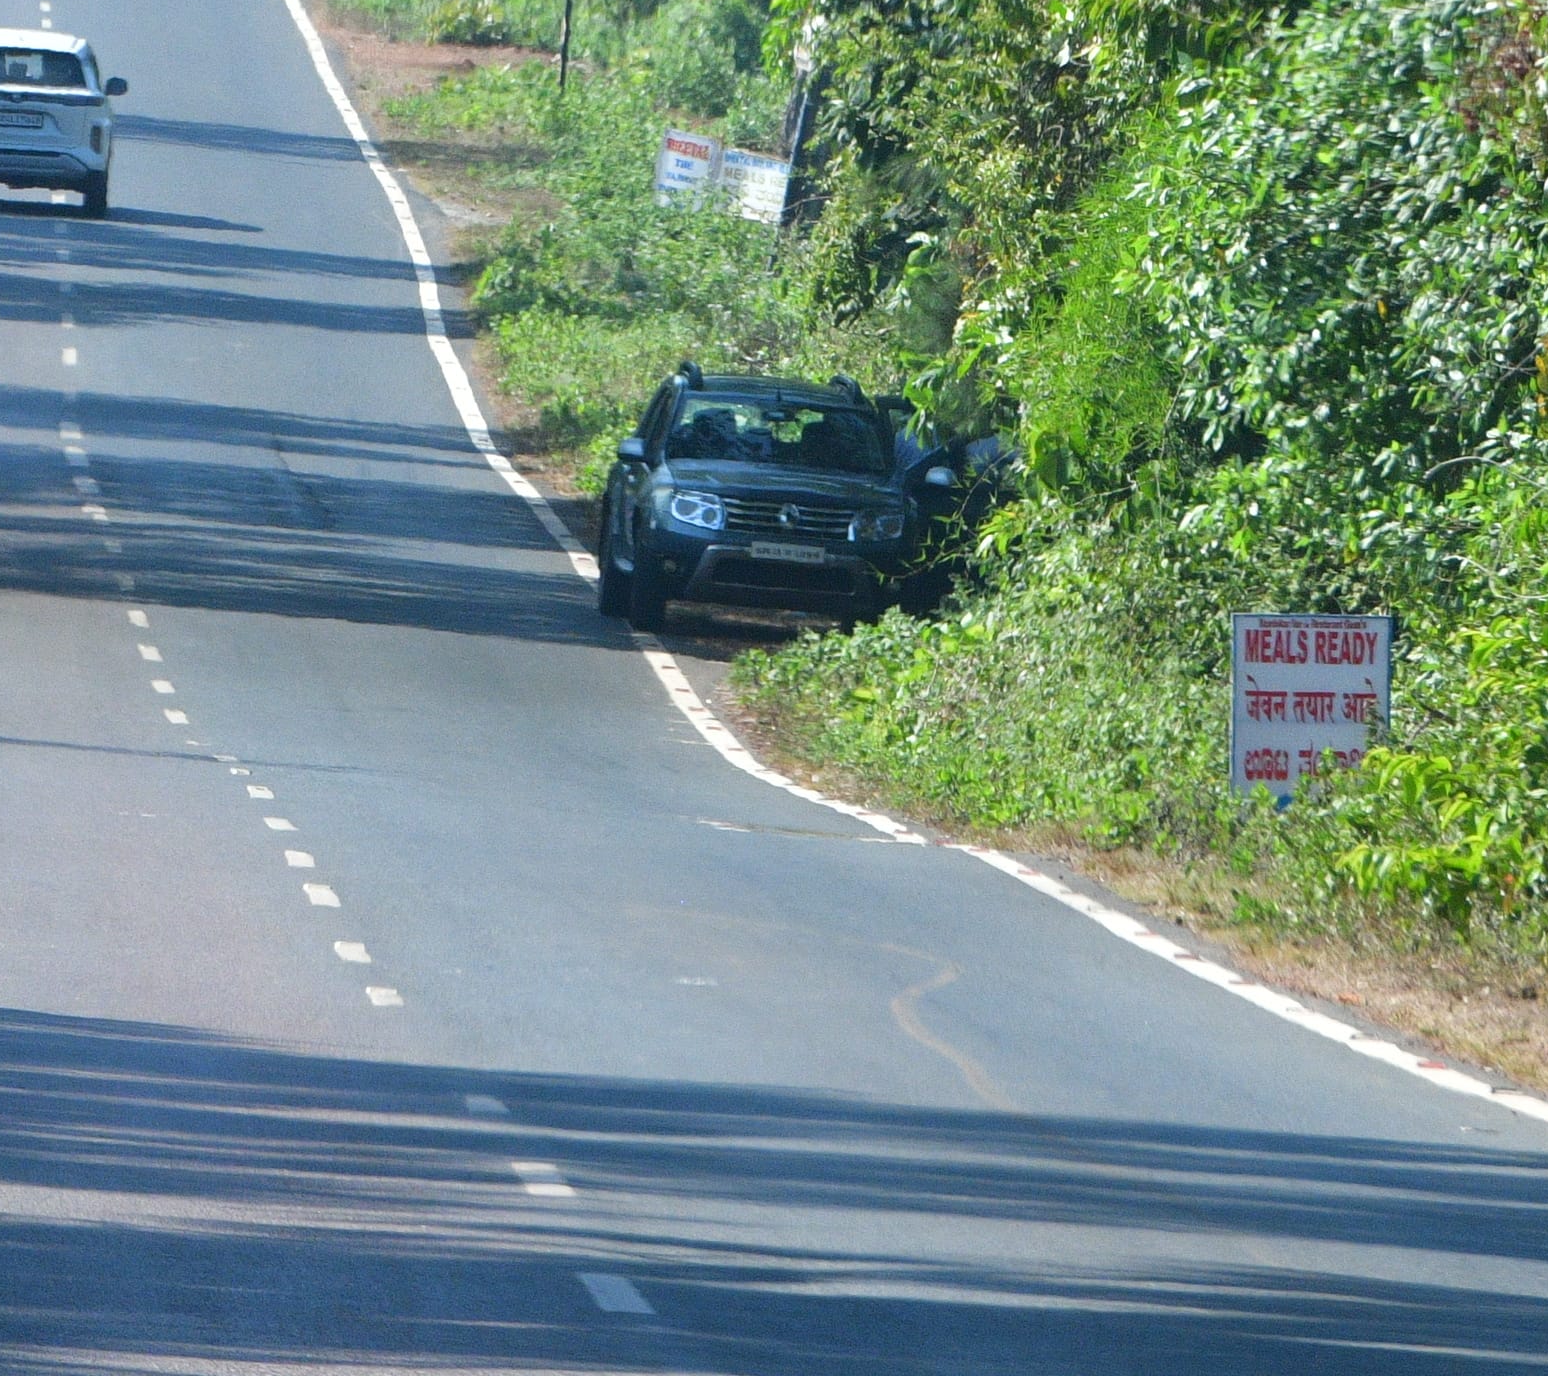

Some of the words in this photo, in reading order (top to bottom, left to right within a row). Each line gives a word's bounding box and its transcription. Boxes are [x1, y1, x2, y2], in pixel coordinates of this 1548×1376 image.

[1245, 629, 1308, 664] MEALS
[1314, 631, 1378, 665] READY
[1245, 674, 1288, 723] जेवन
[1293, 691, 1336, 724] तयार
